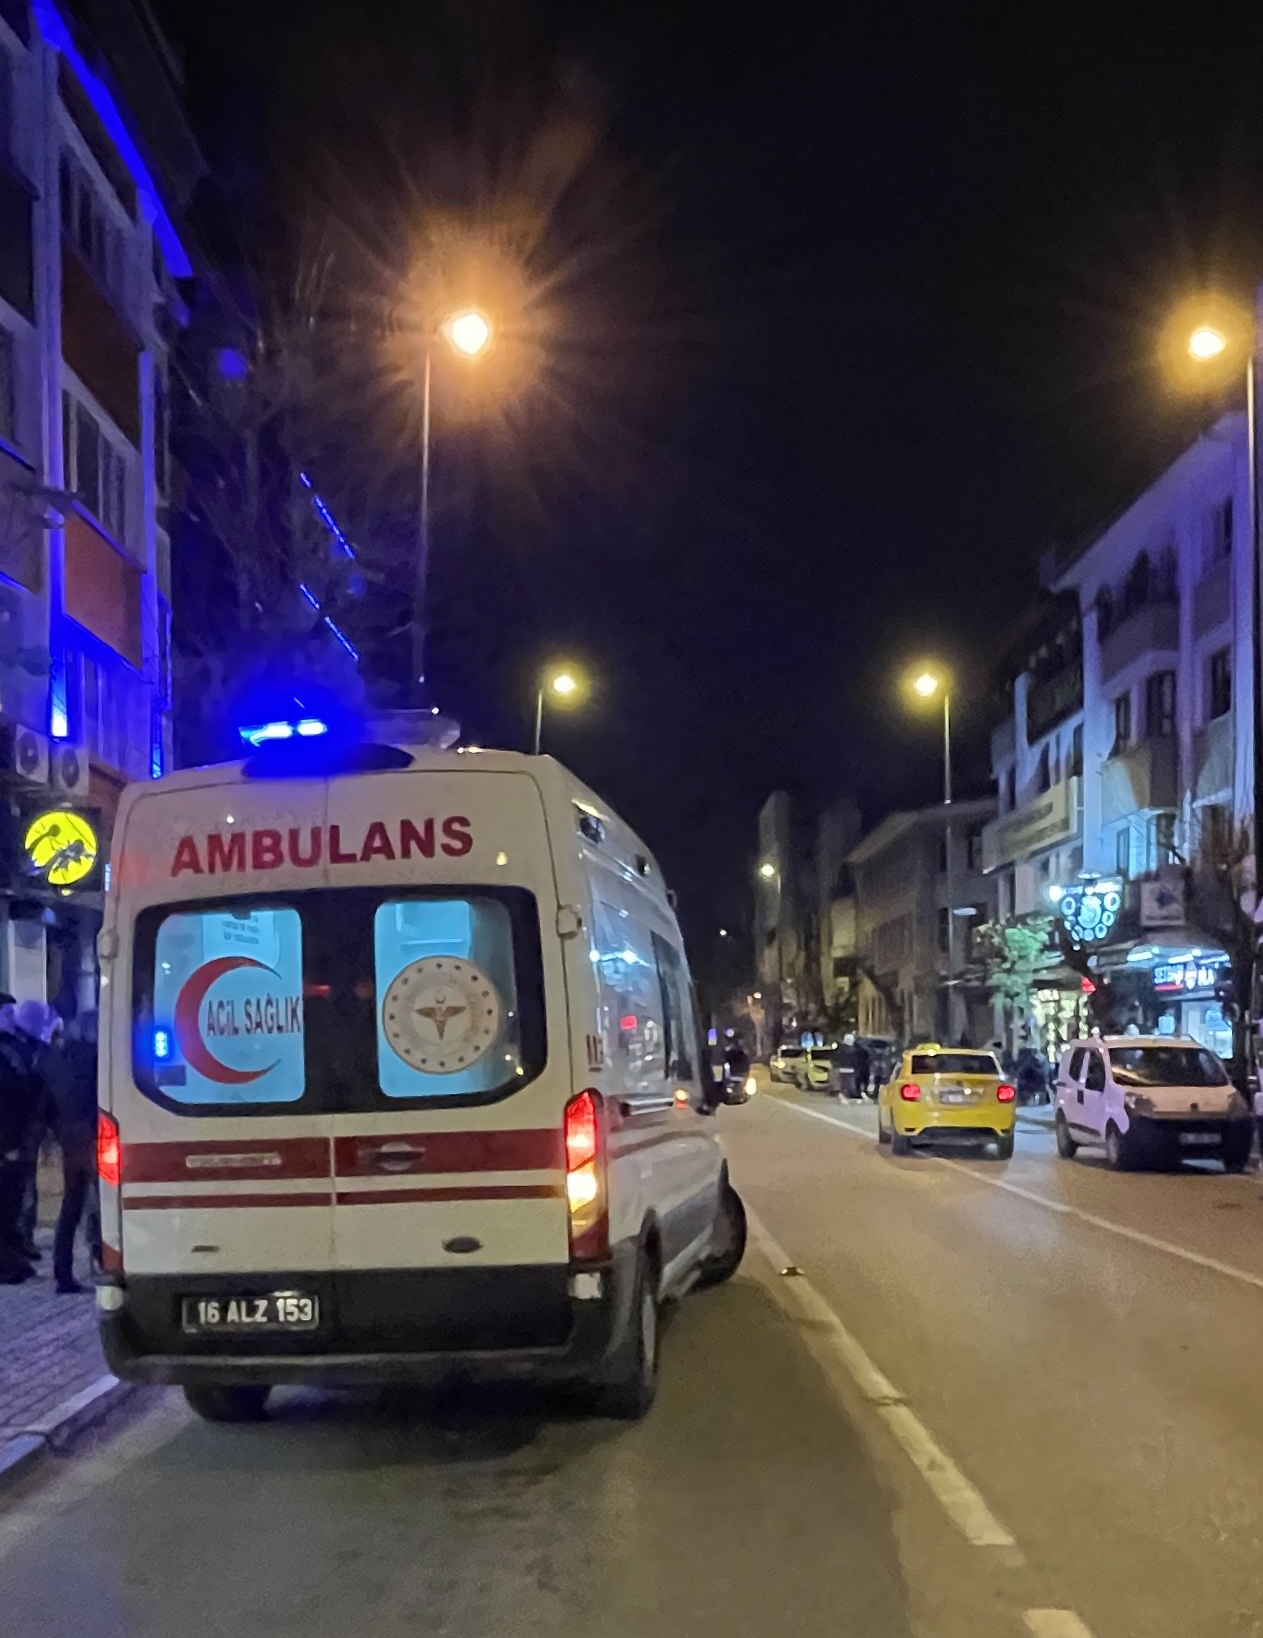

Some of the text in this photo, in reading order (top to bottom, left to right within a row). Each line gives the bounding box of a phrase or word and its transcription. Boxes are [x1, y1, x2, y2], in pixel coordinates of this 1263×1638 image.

[170, 815, 474, 878] AMBULANS
[207, 992, 302, 1037] ACİL SAĞLIK
[199, 1298, 312, 1325] 16 ALZ 153
